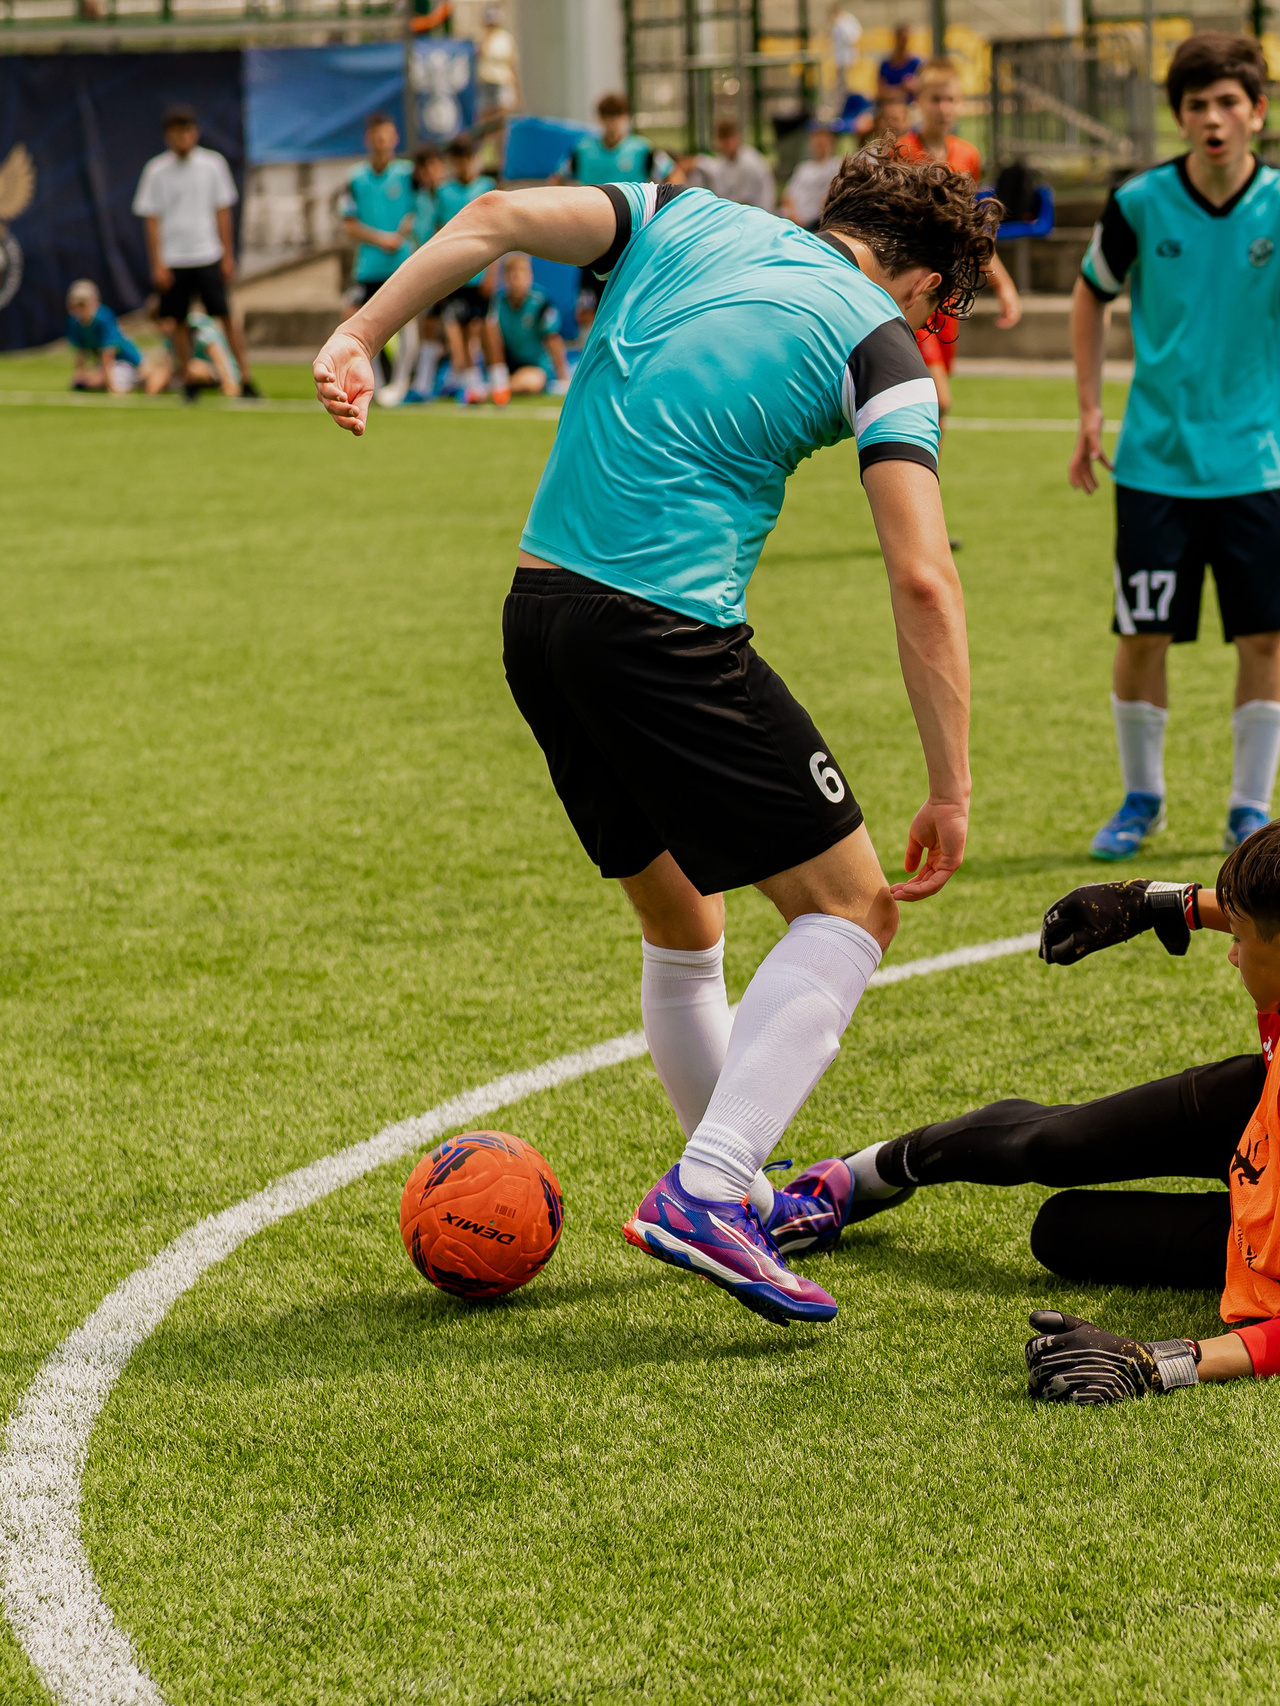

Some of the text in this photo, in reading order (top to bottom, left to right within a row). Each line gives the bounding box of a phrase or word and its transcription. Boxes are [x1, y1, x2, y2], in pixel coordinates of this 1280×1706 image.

[1129, 570, 1176, 621] 17
[809, 751, 845, 803] 6
[440, 1212, 516, 1245] DEMIX
